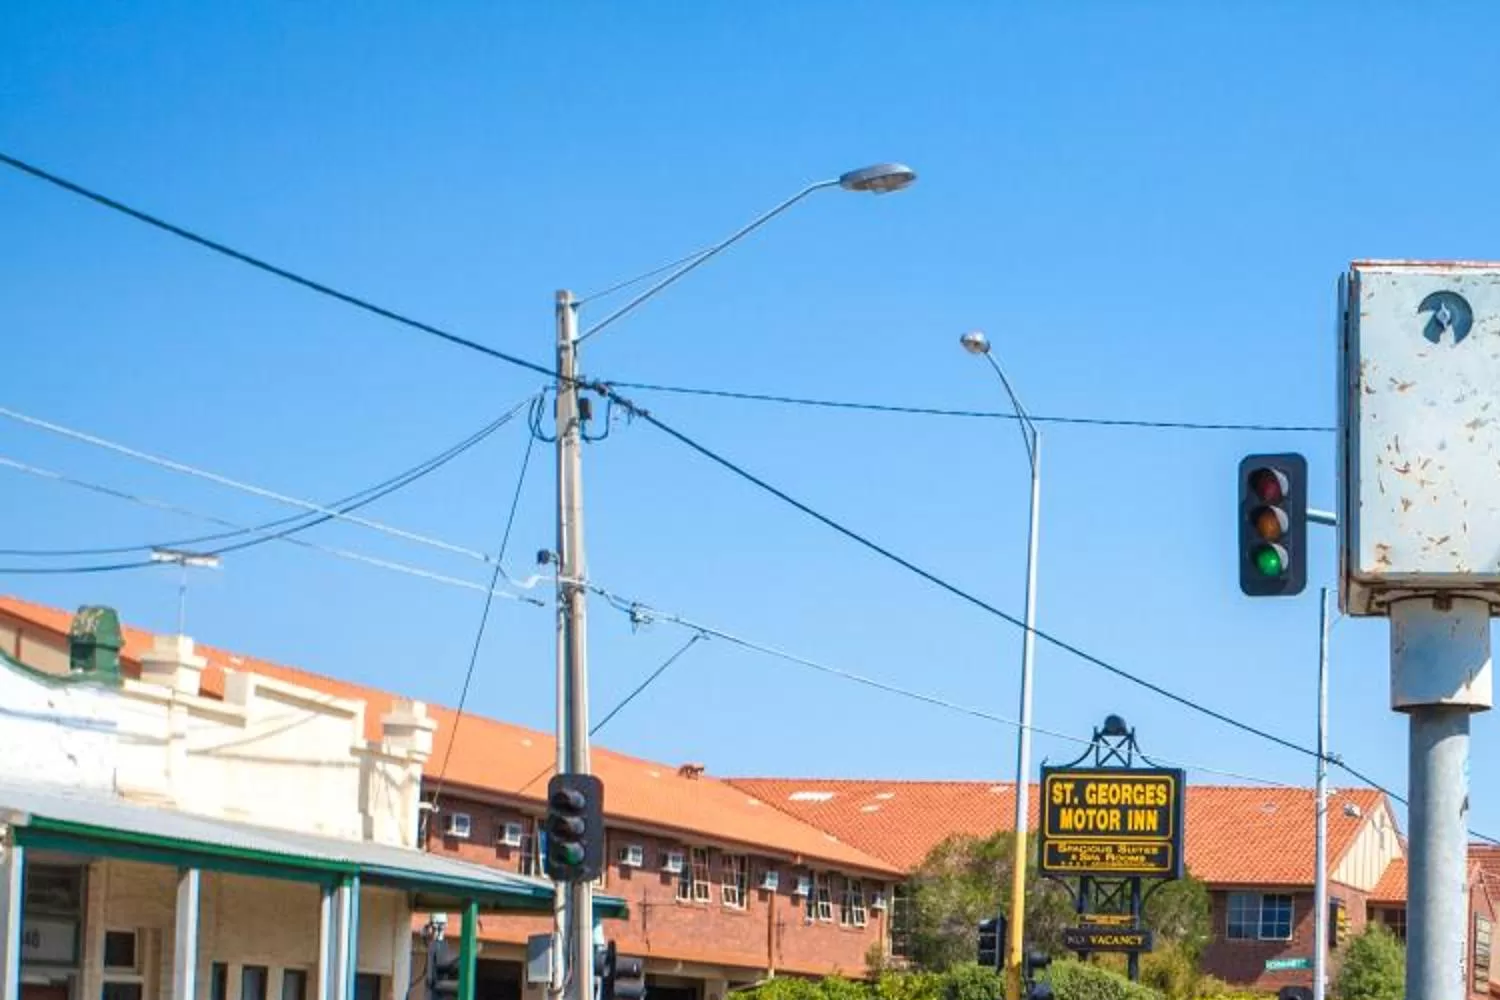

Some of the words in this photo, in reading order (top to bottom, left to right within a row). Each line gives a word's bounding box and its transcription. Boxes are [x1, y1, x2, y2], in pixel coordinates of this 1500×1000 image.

[1052, 781, 1079, 804] ST.
[1085, 782, 1167, 805] GEORGES
[1060, 808, 1120, 831] MOTOR
[1127, 809, 1158, 831] INN
[1088, 935, 1143, 945] VACANCY
